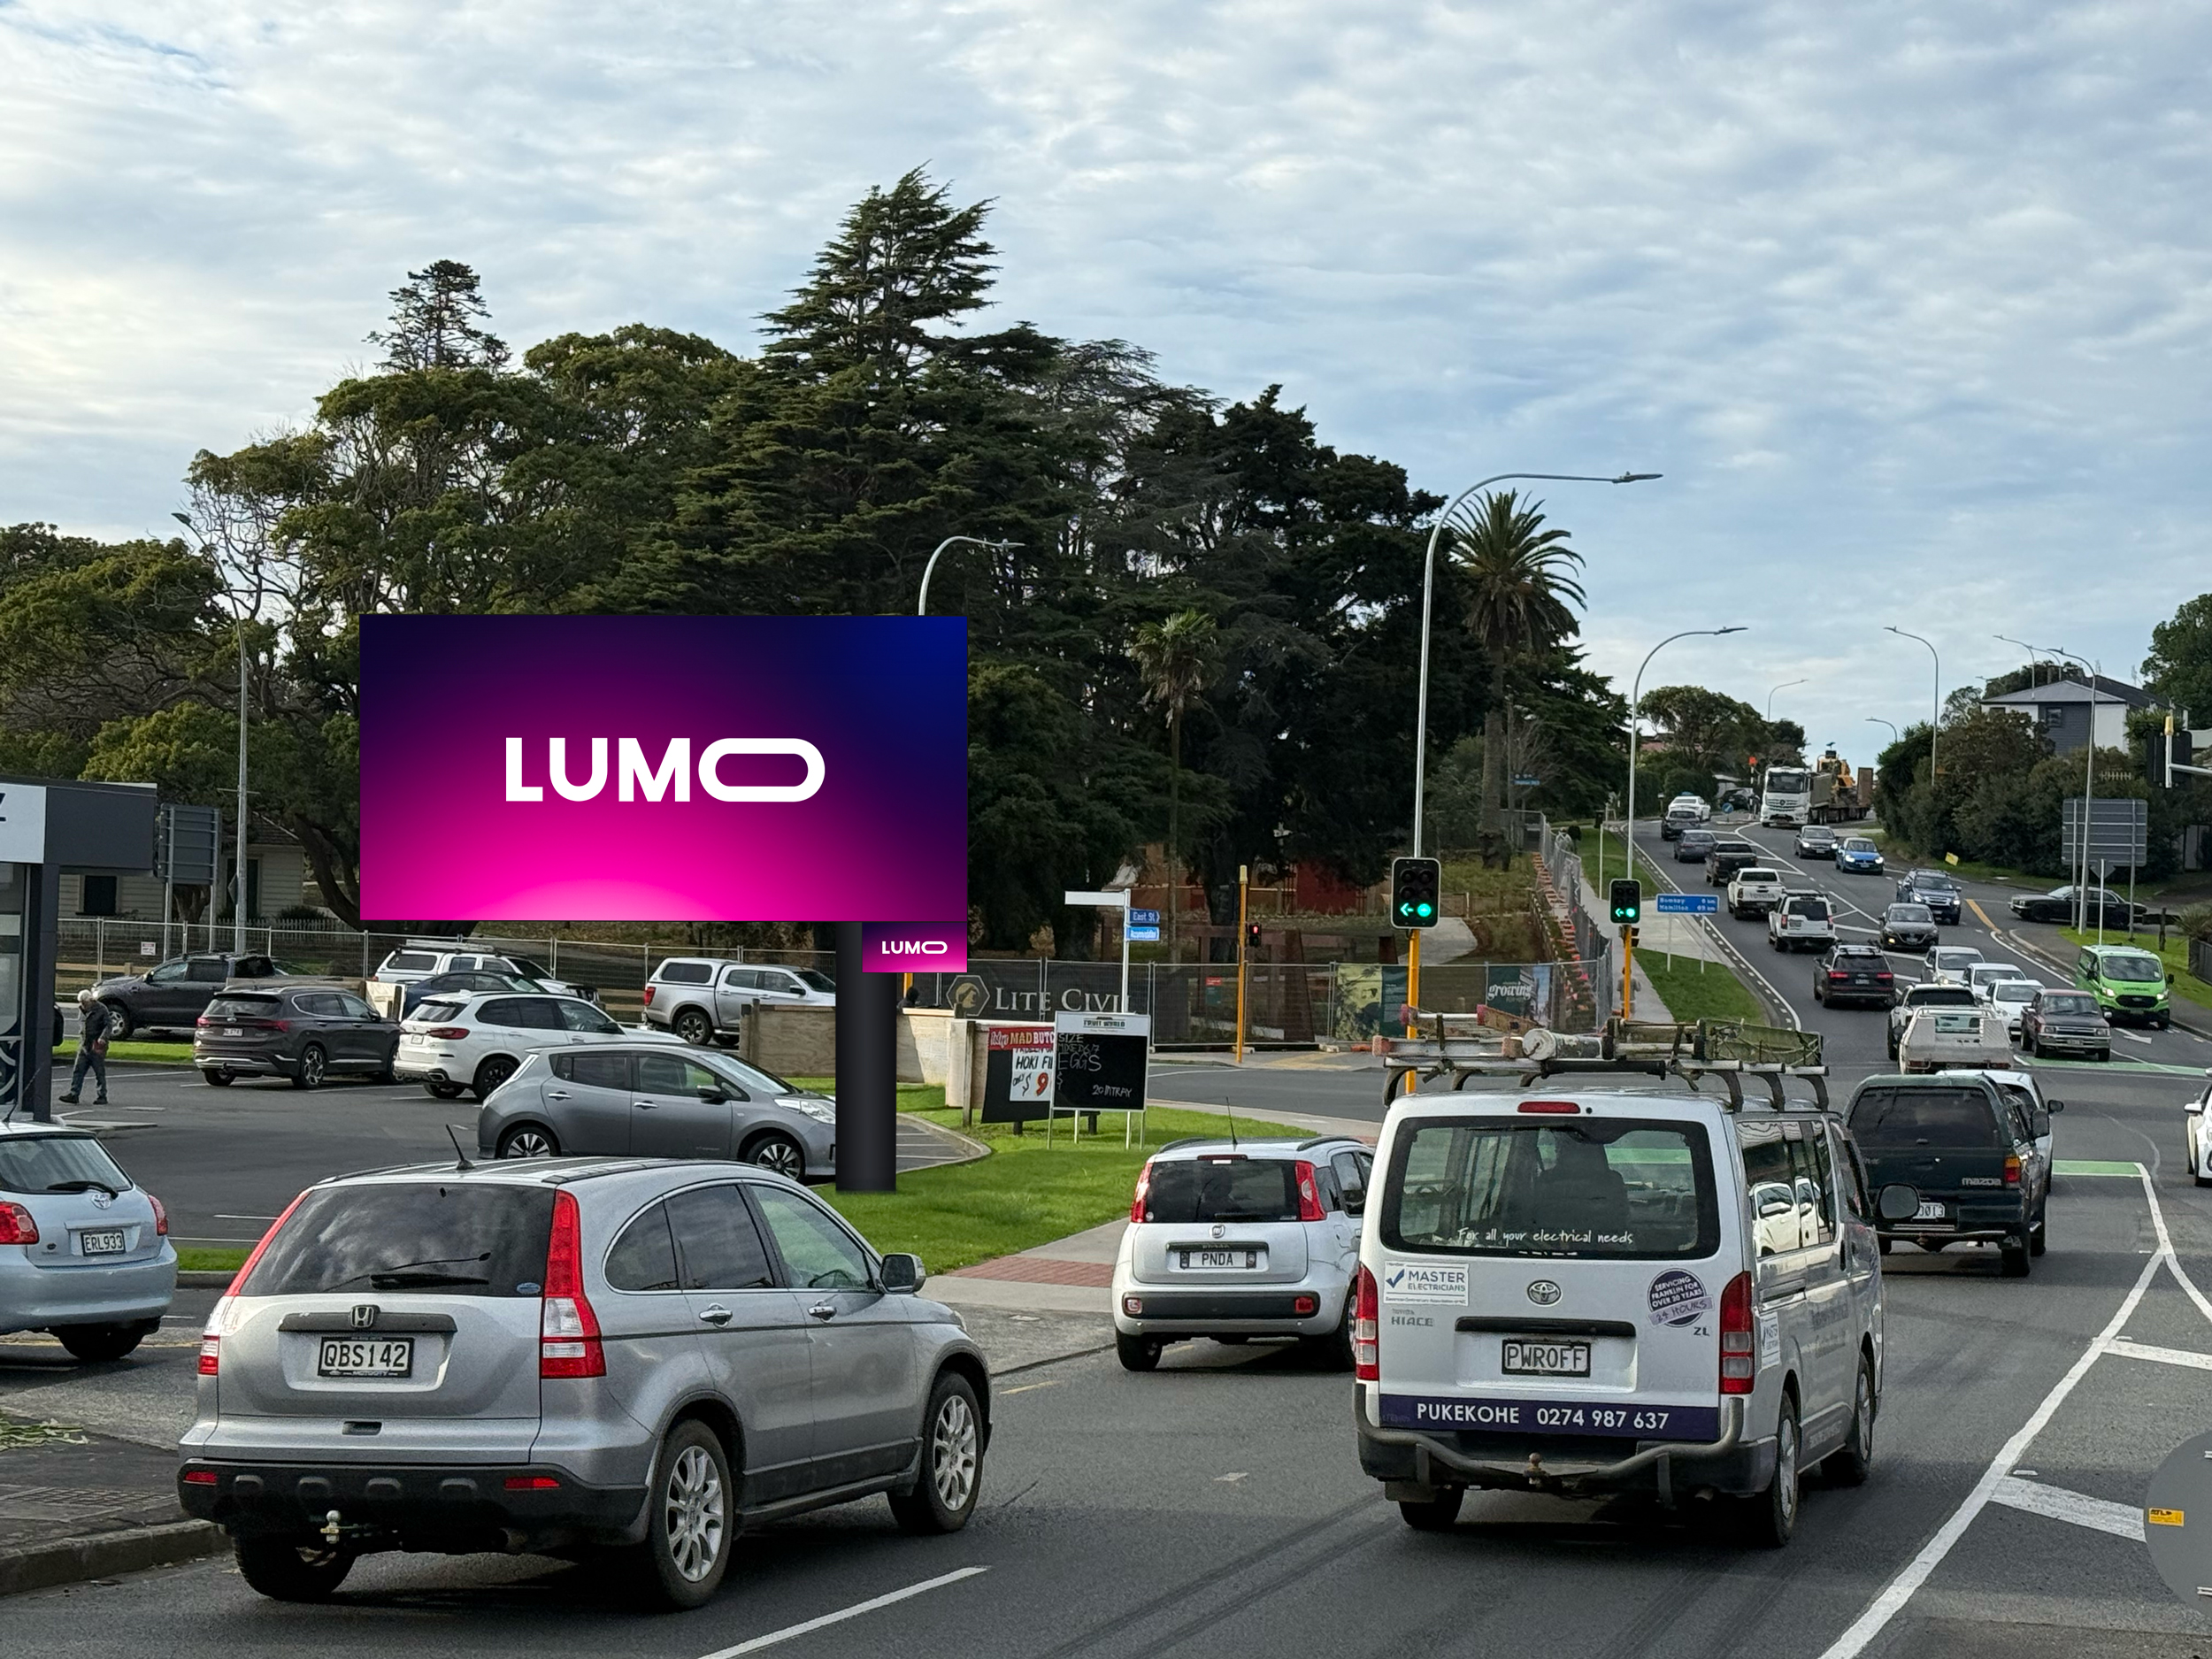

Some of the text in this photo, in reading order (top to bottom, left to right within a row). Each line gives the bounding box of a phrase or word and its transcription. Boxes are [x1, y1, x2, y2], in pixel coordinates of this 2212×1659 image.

[505, 737, 826, 803] LUMO
[1133, 911, 1156, 922] East St
[881, 941, 948, 955] LUMO
[995, 987, 1051, 1011] LITE
[1010, 1032, 1033, 1045] MAD
[1058, 1033, 1084, 1043] SIZE
[1016, 1056, 1039, 1070] HOKI
[1057, 1052, 1102, 1071] EGGS
[85, 1235, 124, 1251] ERL933
[1457, 1226, 1633, 1248] For all your electrical needs
[1202, 1253, 1233, 1266] PNDA
[1408, 1271, 1465, 1283] MASTER
[1655, 1276, 1691, 1292] SERVICING
[1408, 1282, 1466, 1292] ELECTRICIANS
[1651, 1281, 1699, 1300] FRANKLIN FOR
[1652, 1296, 1671, 1308] OVER
[1681, 1288, 1702, 1300] YEARS
[1655, 1300, 1708, 1324] 24 HOURS
[1391, 1316, 1433, 1327] HIACE
[1694, 1326, 1710, 1337] ZL
[324, 1343, 407, 1368] QBS142
[1506, 1346, 1586, 1369] PWROFF
[1417, 1403, 1520, 1424] PUKEKOHE
[1536, 1407, 1585, 1427] 0274
[1591, 1410, 1626, 1428] 987
[1632, 1411, 1670, 1430] 637
